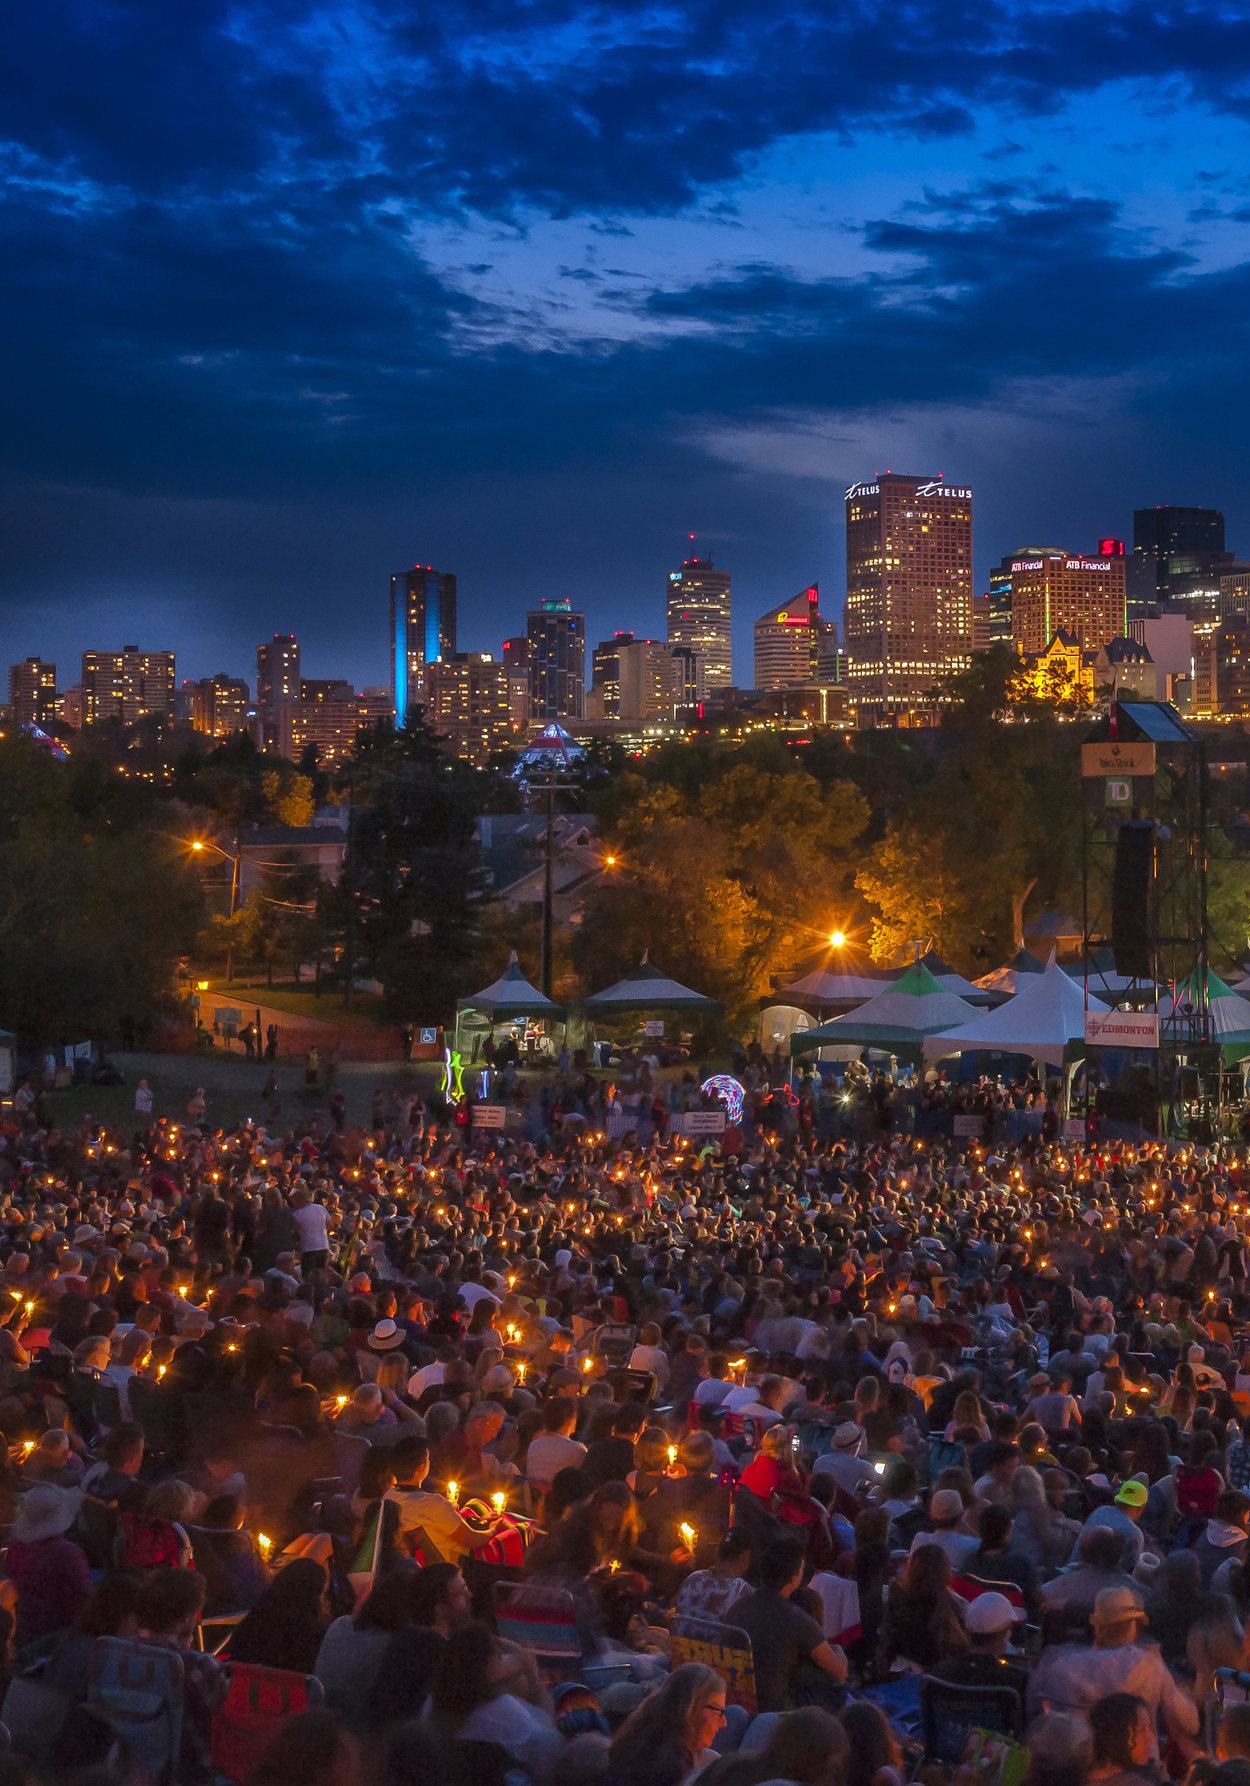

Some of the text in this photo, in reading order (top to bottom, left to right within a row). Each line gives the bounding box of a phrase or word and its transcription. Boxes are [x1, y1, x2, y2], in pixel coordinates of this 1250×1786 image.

[937, 487, 972, 499] TELUS
[1011, 559, 1043, 572] ATB Financial
[1066, 560, 1111, 571] ATB Financial
[1108, 781, 1130, 801] TD
[1102, 1025, 1155, 1035] EDMONTON
